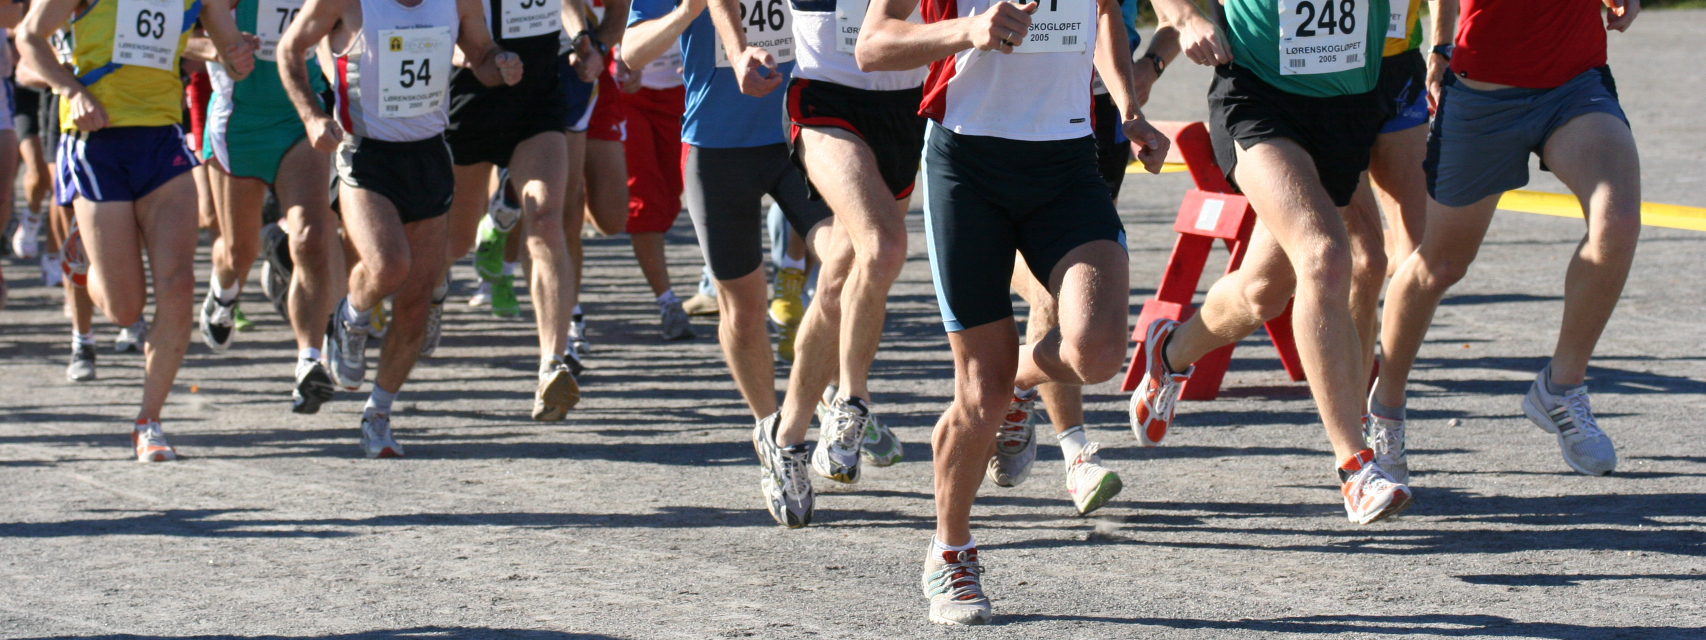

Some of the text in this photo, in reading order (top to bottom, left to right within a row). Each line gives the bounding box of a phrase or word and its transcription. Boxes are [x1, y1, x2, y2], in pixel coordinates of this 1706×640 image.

[136, 8, 165, 39] 63
[506, 10, 558, 24] LØRENSKOGLØPET
[1296, 0, 1356, 37] 248
[1029, 22, 1081, 31] SKOGLØPET
[118, 42, 171, 54] LØRENSKOGLØPET
[1286, 41, 1361, 55] LØRENSKOGLØPET
[1319, 55, 1337, 63] 2005
[399, 58, 431, 88] 54
[383, 90, 443, 102] LØRENSKOGLØPET
